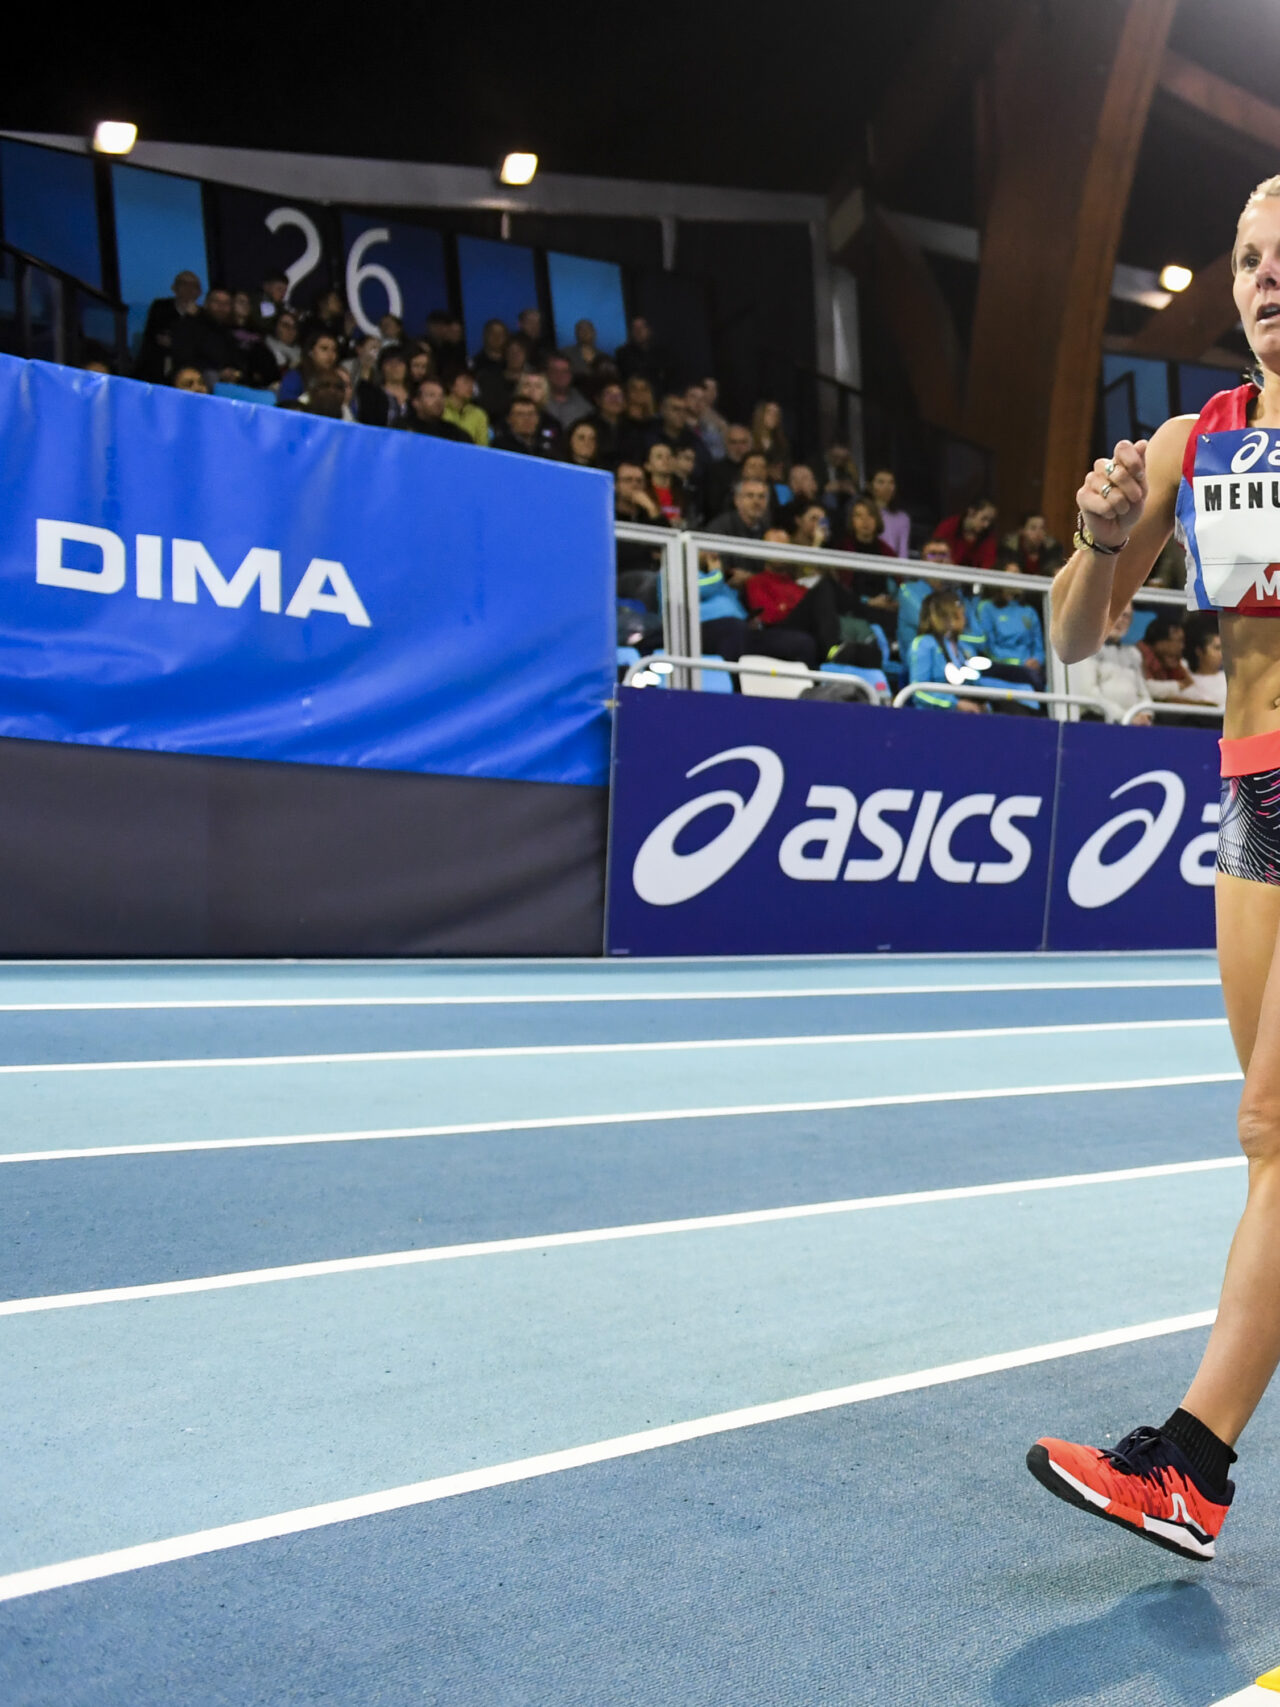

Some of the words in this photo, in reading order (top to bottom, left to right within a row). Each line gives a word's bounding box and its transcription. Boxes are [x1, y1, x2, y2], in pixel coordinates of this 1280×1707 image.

[265, 206, 402, 339] 26
[35, 517, 372, 628] DIMA
[778, 784, 1043, 885] asics
